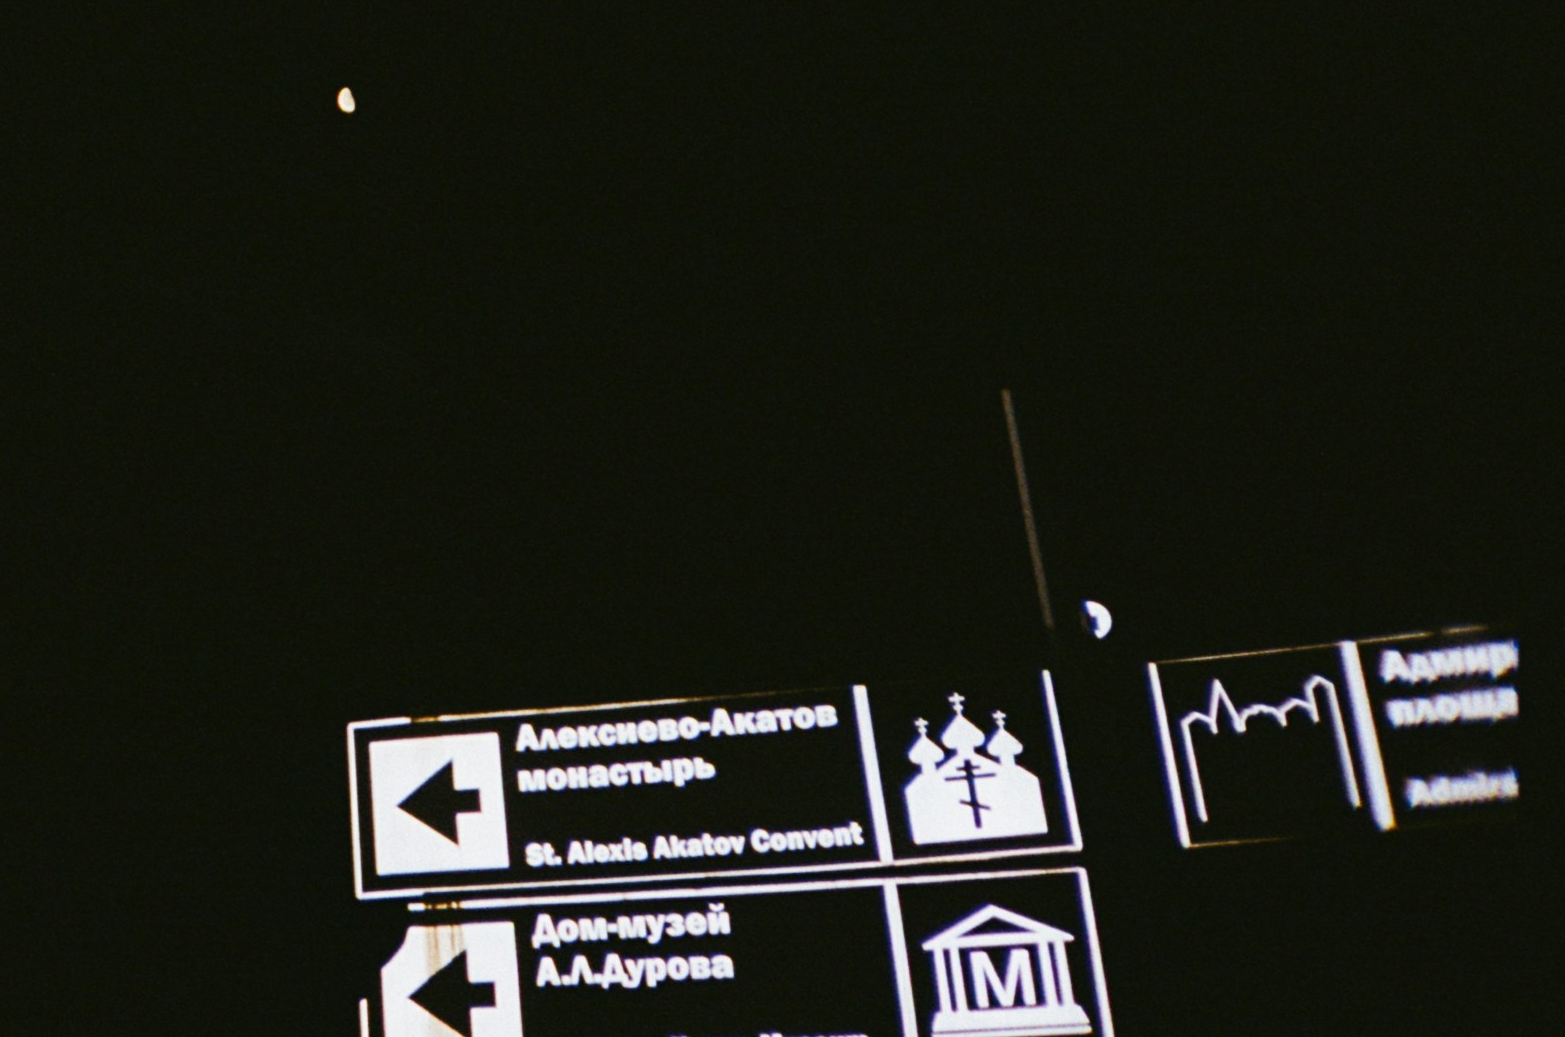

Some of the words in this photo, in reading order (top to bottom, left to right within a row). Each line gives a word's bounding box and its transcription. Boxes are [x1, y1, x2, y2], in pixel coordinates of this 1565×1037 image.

[516, 704, 839, 752] Алексиево-Акатов
[517, 756, 717, 792] монастырь
[525, 843, 563, 868] St.
[567, 838, 649, 865] Alexis
[653, 833, 746, 860] Akatov
[750, 822, 865, 854] Convent
[531, 903, 732, 949] Дом-музей
[535, 953, 735, 990] А.Л.Дурова
